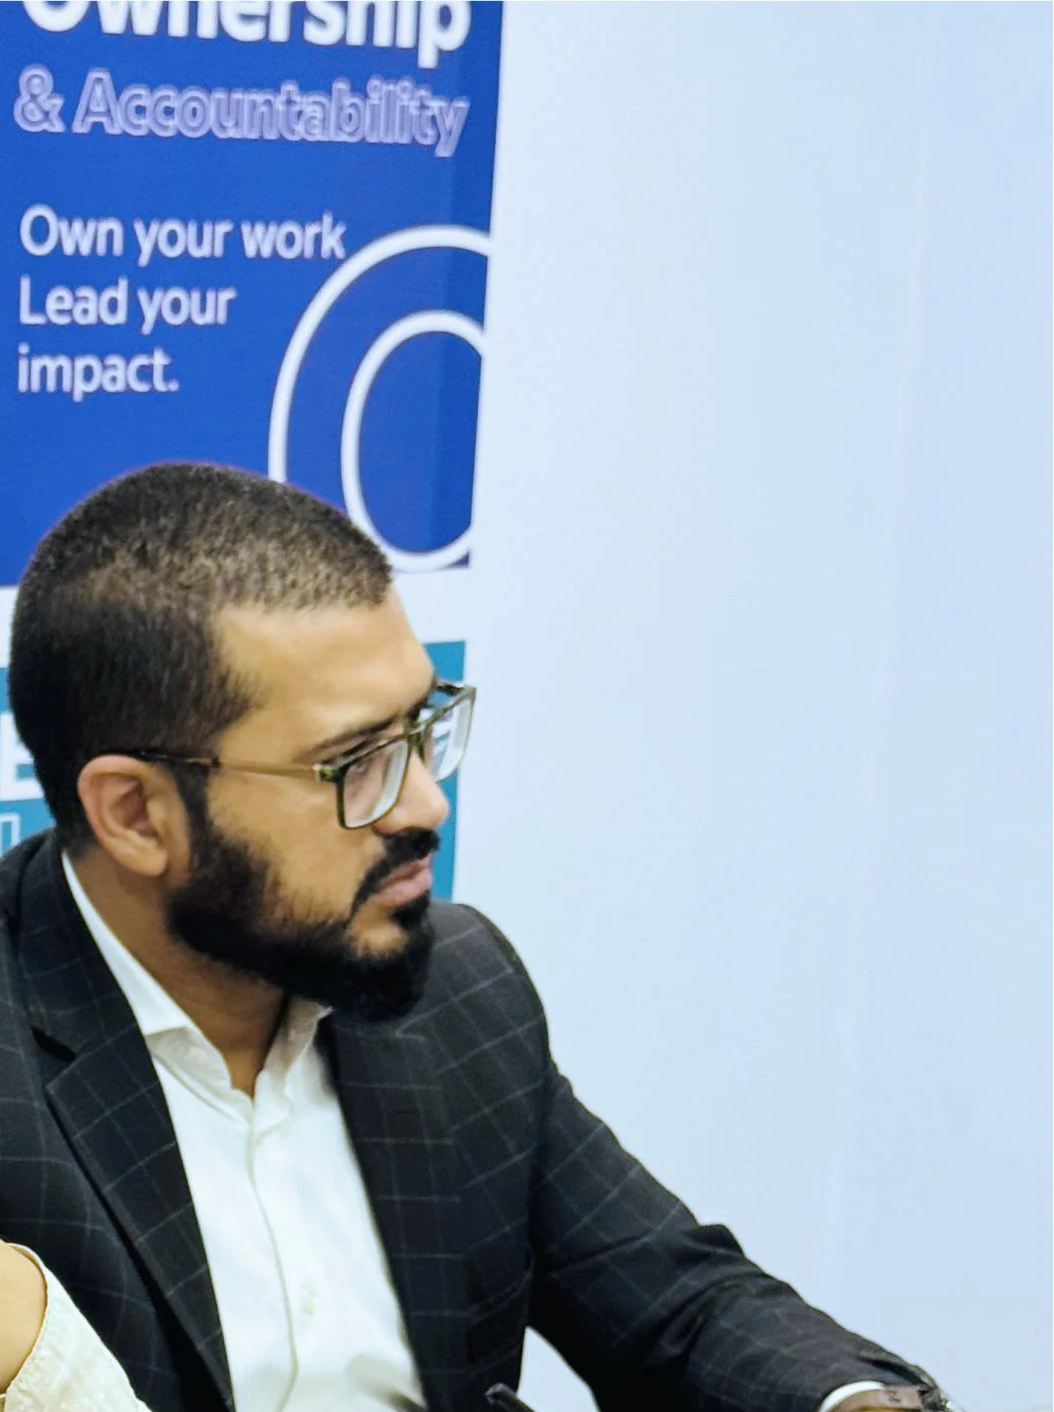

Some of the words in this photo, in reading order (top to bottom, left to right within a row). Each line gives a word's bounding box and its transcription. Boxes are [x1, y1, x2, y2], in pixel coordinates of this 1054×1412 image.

[14, 65, 65, 133] &
[73, 68, 470, 157] Accountability
[20, 204, 123, 257] Own
[134, 219, 233, 268] your
[242, 210, 346, 260] work
[19, 276, 128, 325] Lead
[139, 287, 237, 335] your
[18, 344, 179, 402] impact.
